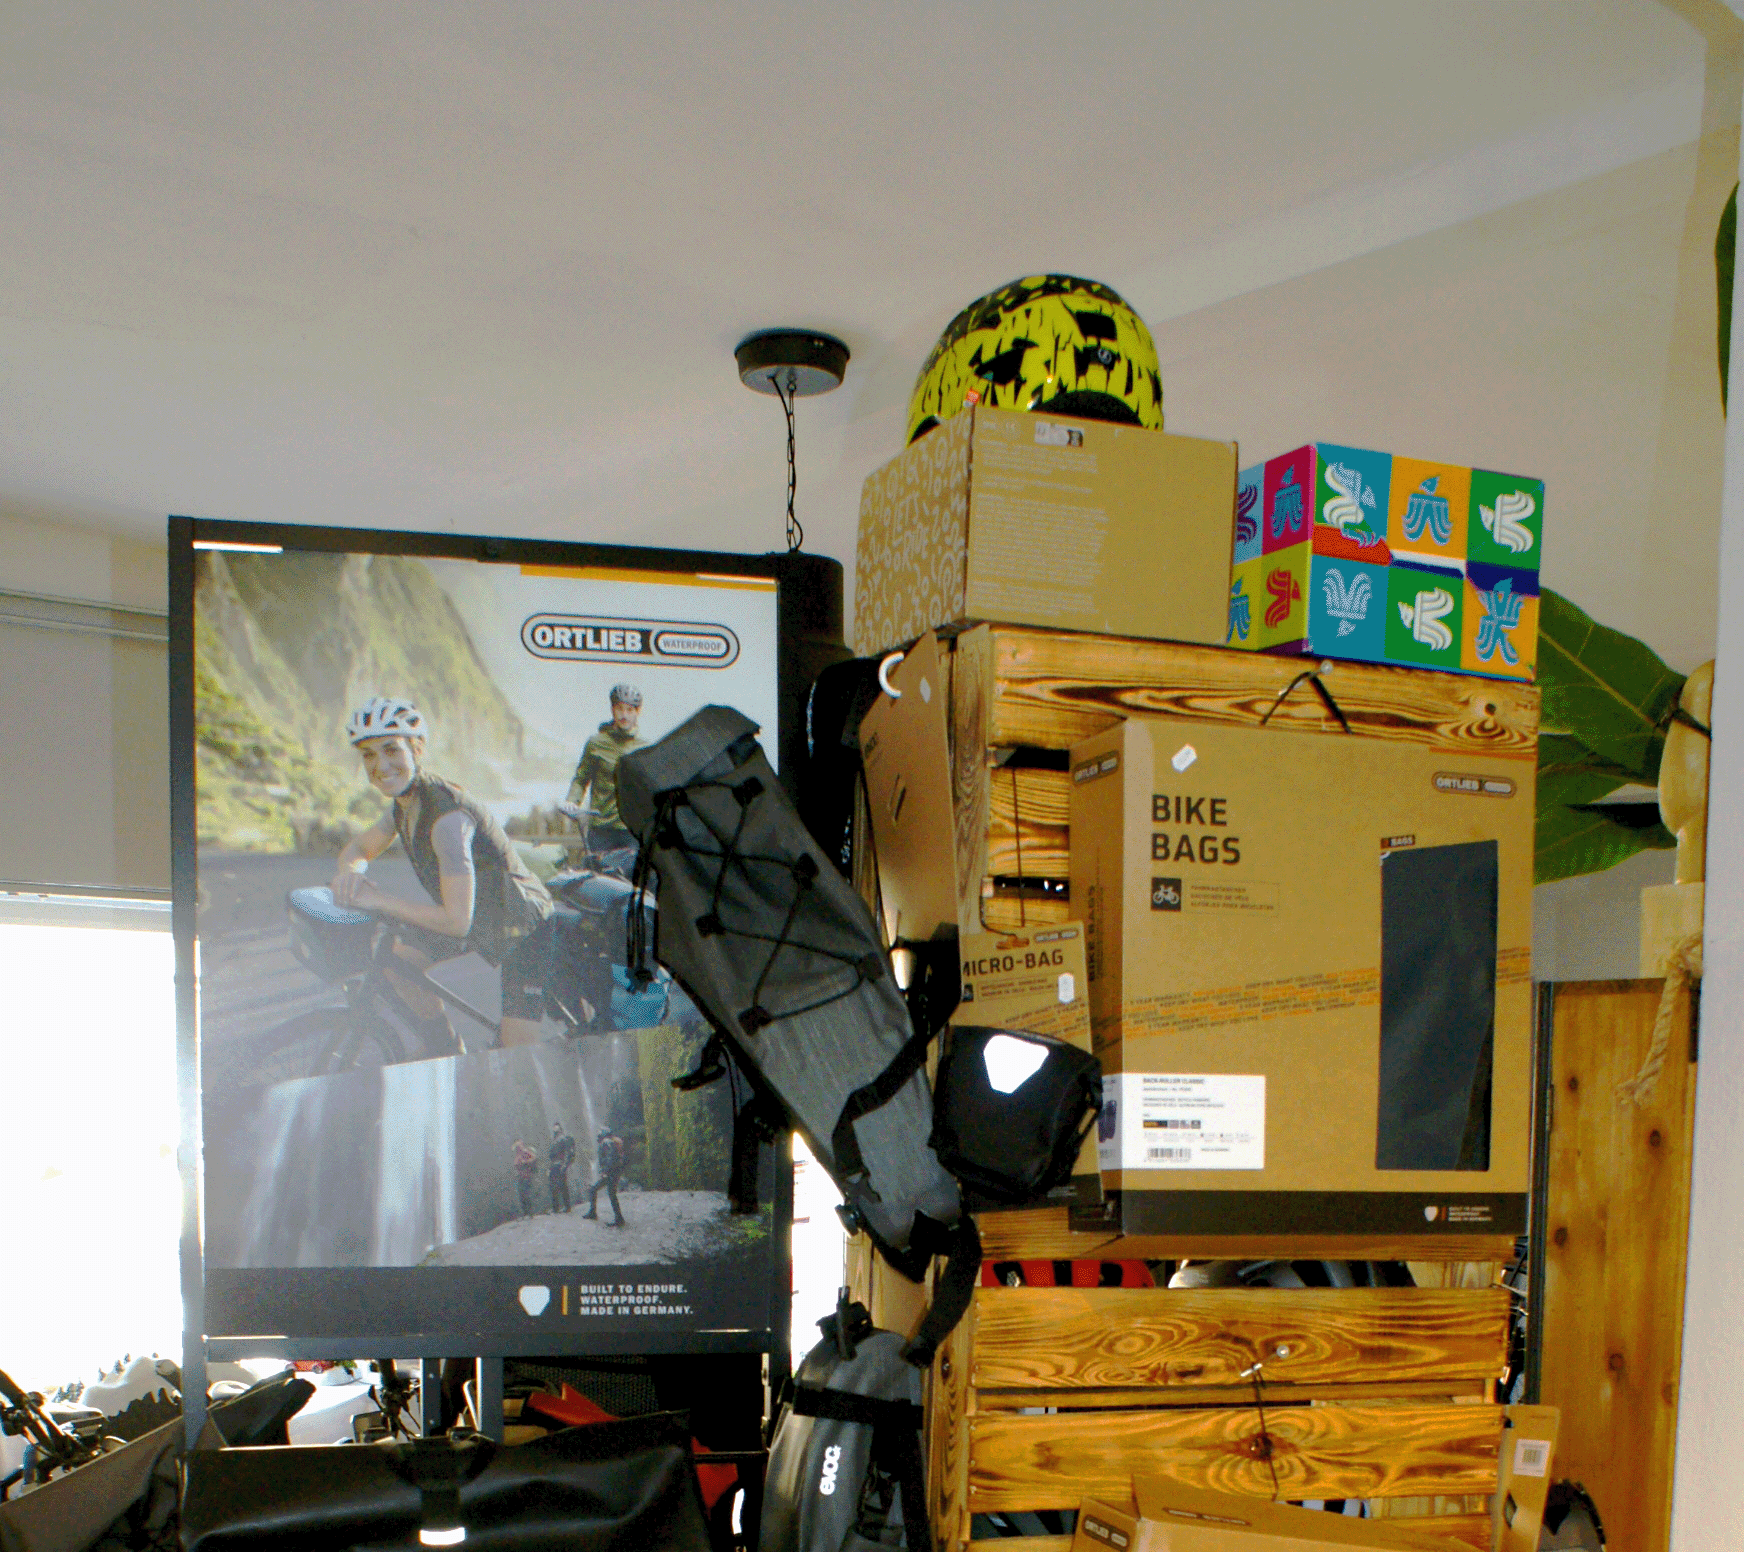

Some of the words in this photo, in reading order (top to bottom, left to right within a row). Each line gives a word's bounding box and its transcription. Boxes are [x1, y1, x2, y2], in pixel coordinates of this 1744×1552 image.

[533, 625, 643, 652] ORTLIEB
[662, 638, 723, 651] WATERPROOF
[1151, 793, 1228, 827] BIKE
[1150, 832, 1241, 866] BAGS
[962, 948, 1064, 977] MICRO-BAG
[580, 1284, 615, 1294] BUILT
[618, 1284, 634, 1294] TO
[637, 1283, 688, 1294] ENDURE.
[580, 1295, 663, 1305] WATERPROOF.
[580, 1305, 614, 1315] MADE
[618, 1305, 630, 1315] IN
[633, 1305, 694, 1315] GERMANY.
